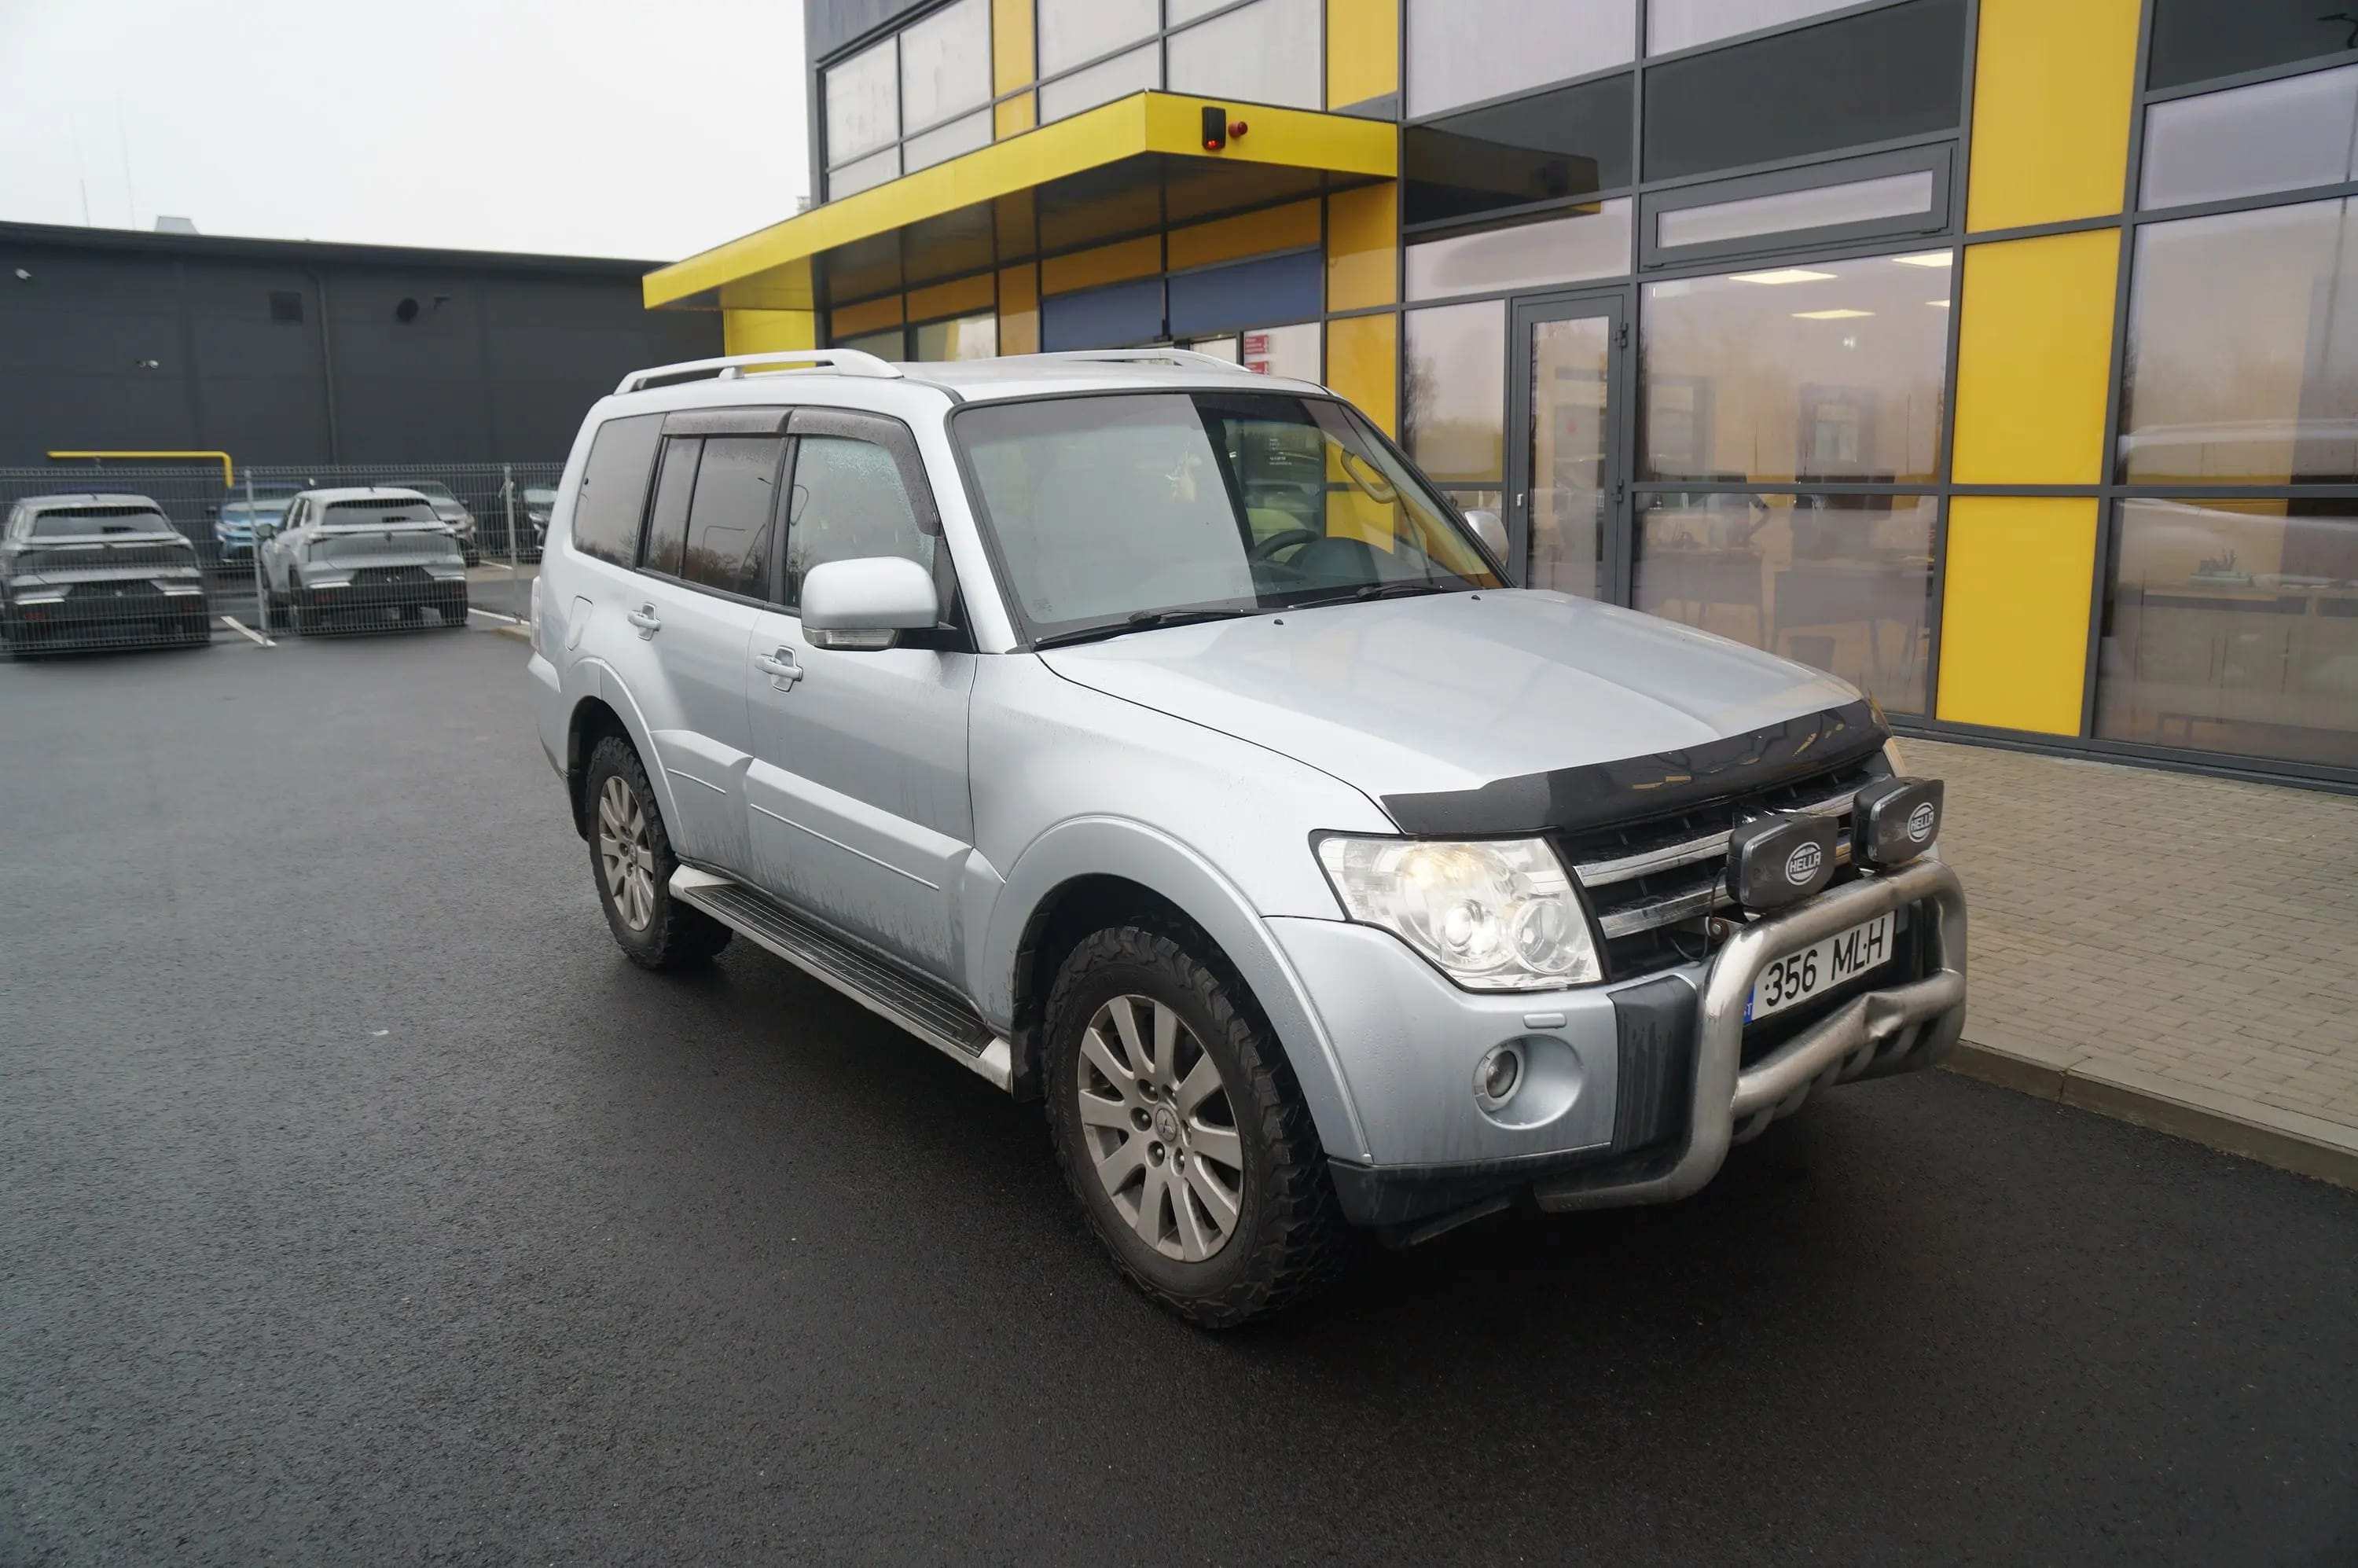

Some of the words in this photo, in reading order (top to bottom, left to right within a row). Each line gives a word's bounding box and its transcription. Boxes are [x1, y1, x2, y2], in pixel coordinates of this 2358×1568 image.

[1790, 851, 1821, 872] HELLA
[1766, 949, 1818, 1007] 356
[1831, 917, 1885, 981] MLH
